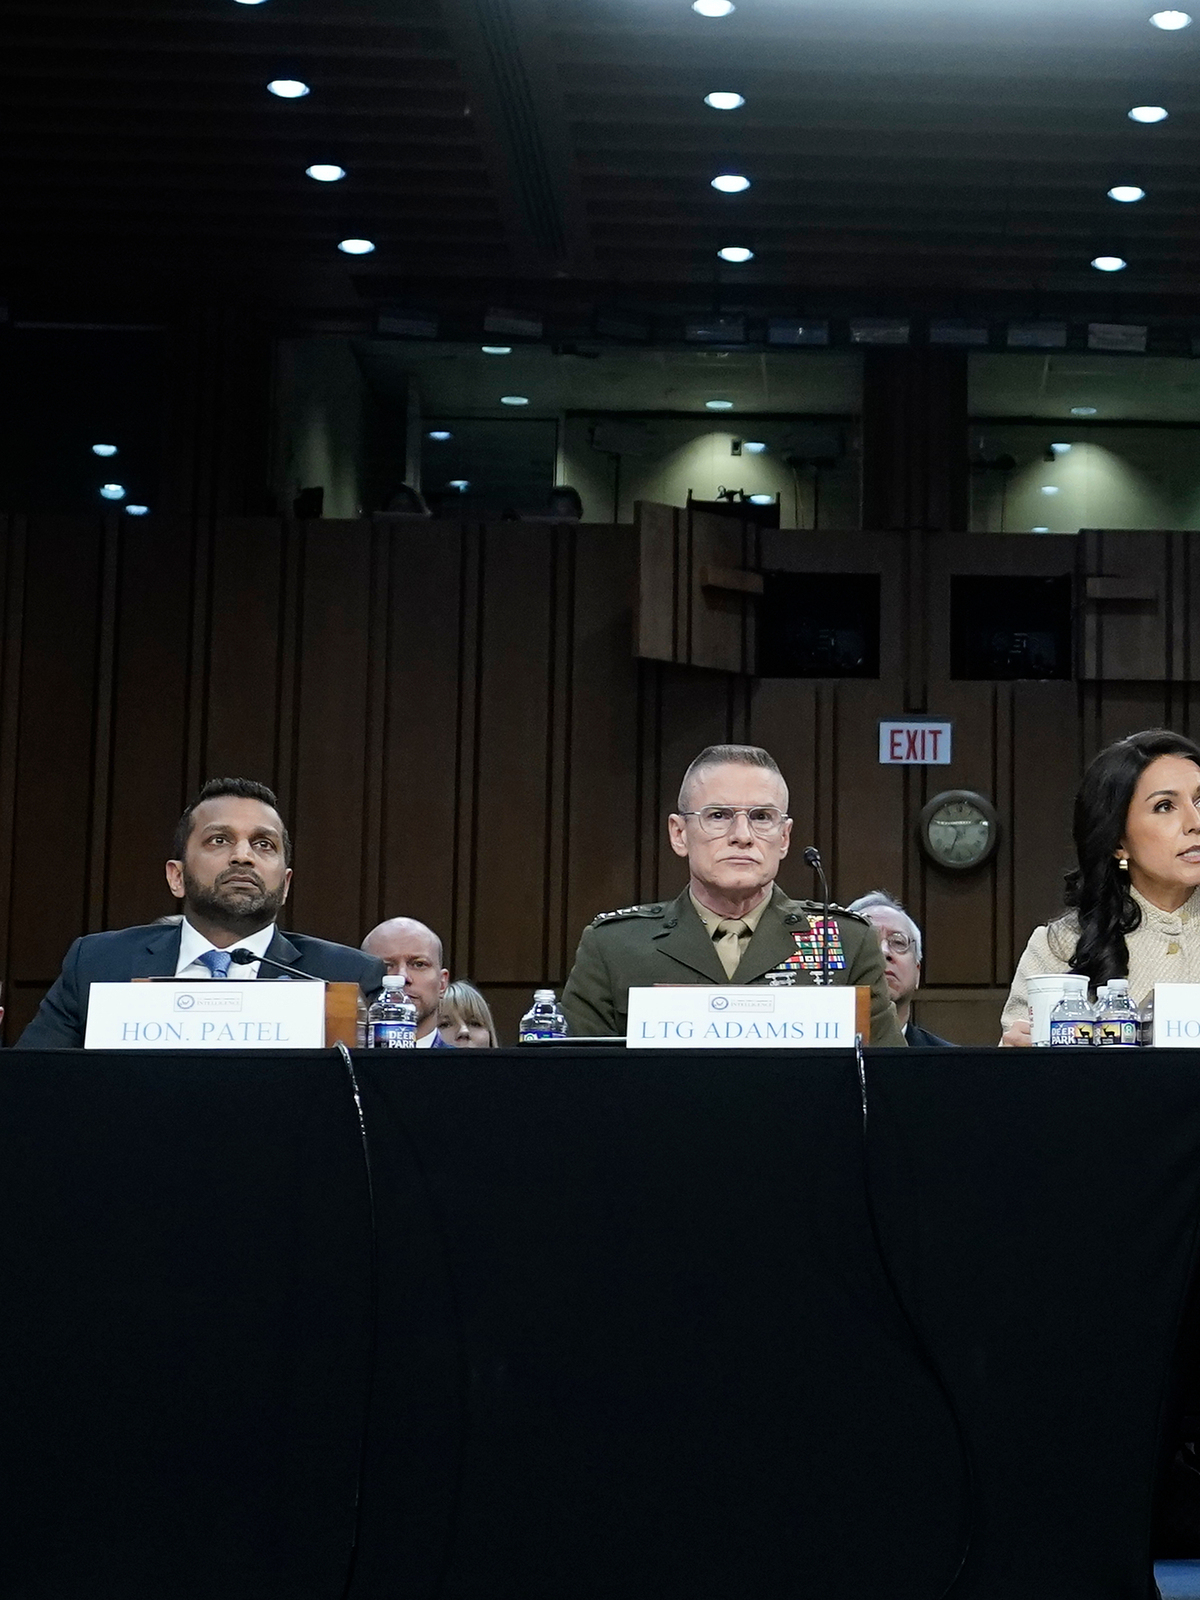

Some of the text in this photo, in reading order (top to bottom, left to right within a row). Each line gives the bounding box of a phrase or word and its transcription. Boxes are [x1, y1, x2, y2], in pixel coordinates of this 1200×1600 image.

[889, 729, 943, 761] EXIT
[121, 1021, 290, 1042] HON. PATEL
[388, 1030, 415, 1040] DEER
[641, 1021, 840, 1040] LTG ADAMS III
[1051, 1026, 1075, 1036] DEER
[388, 1039, 415, 1049] PARK
[1051, 1035, 1076, 1045] PARK
